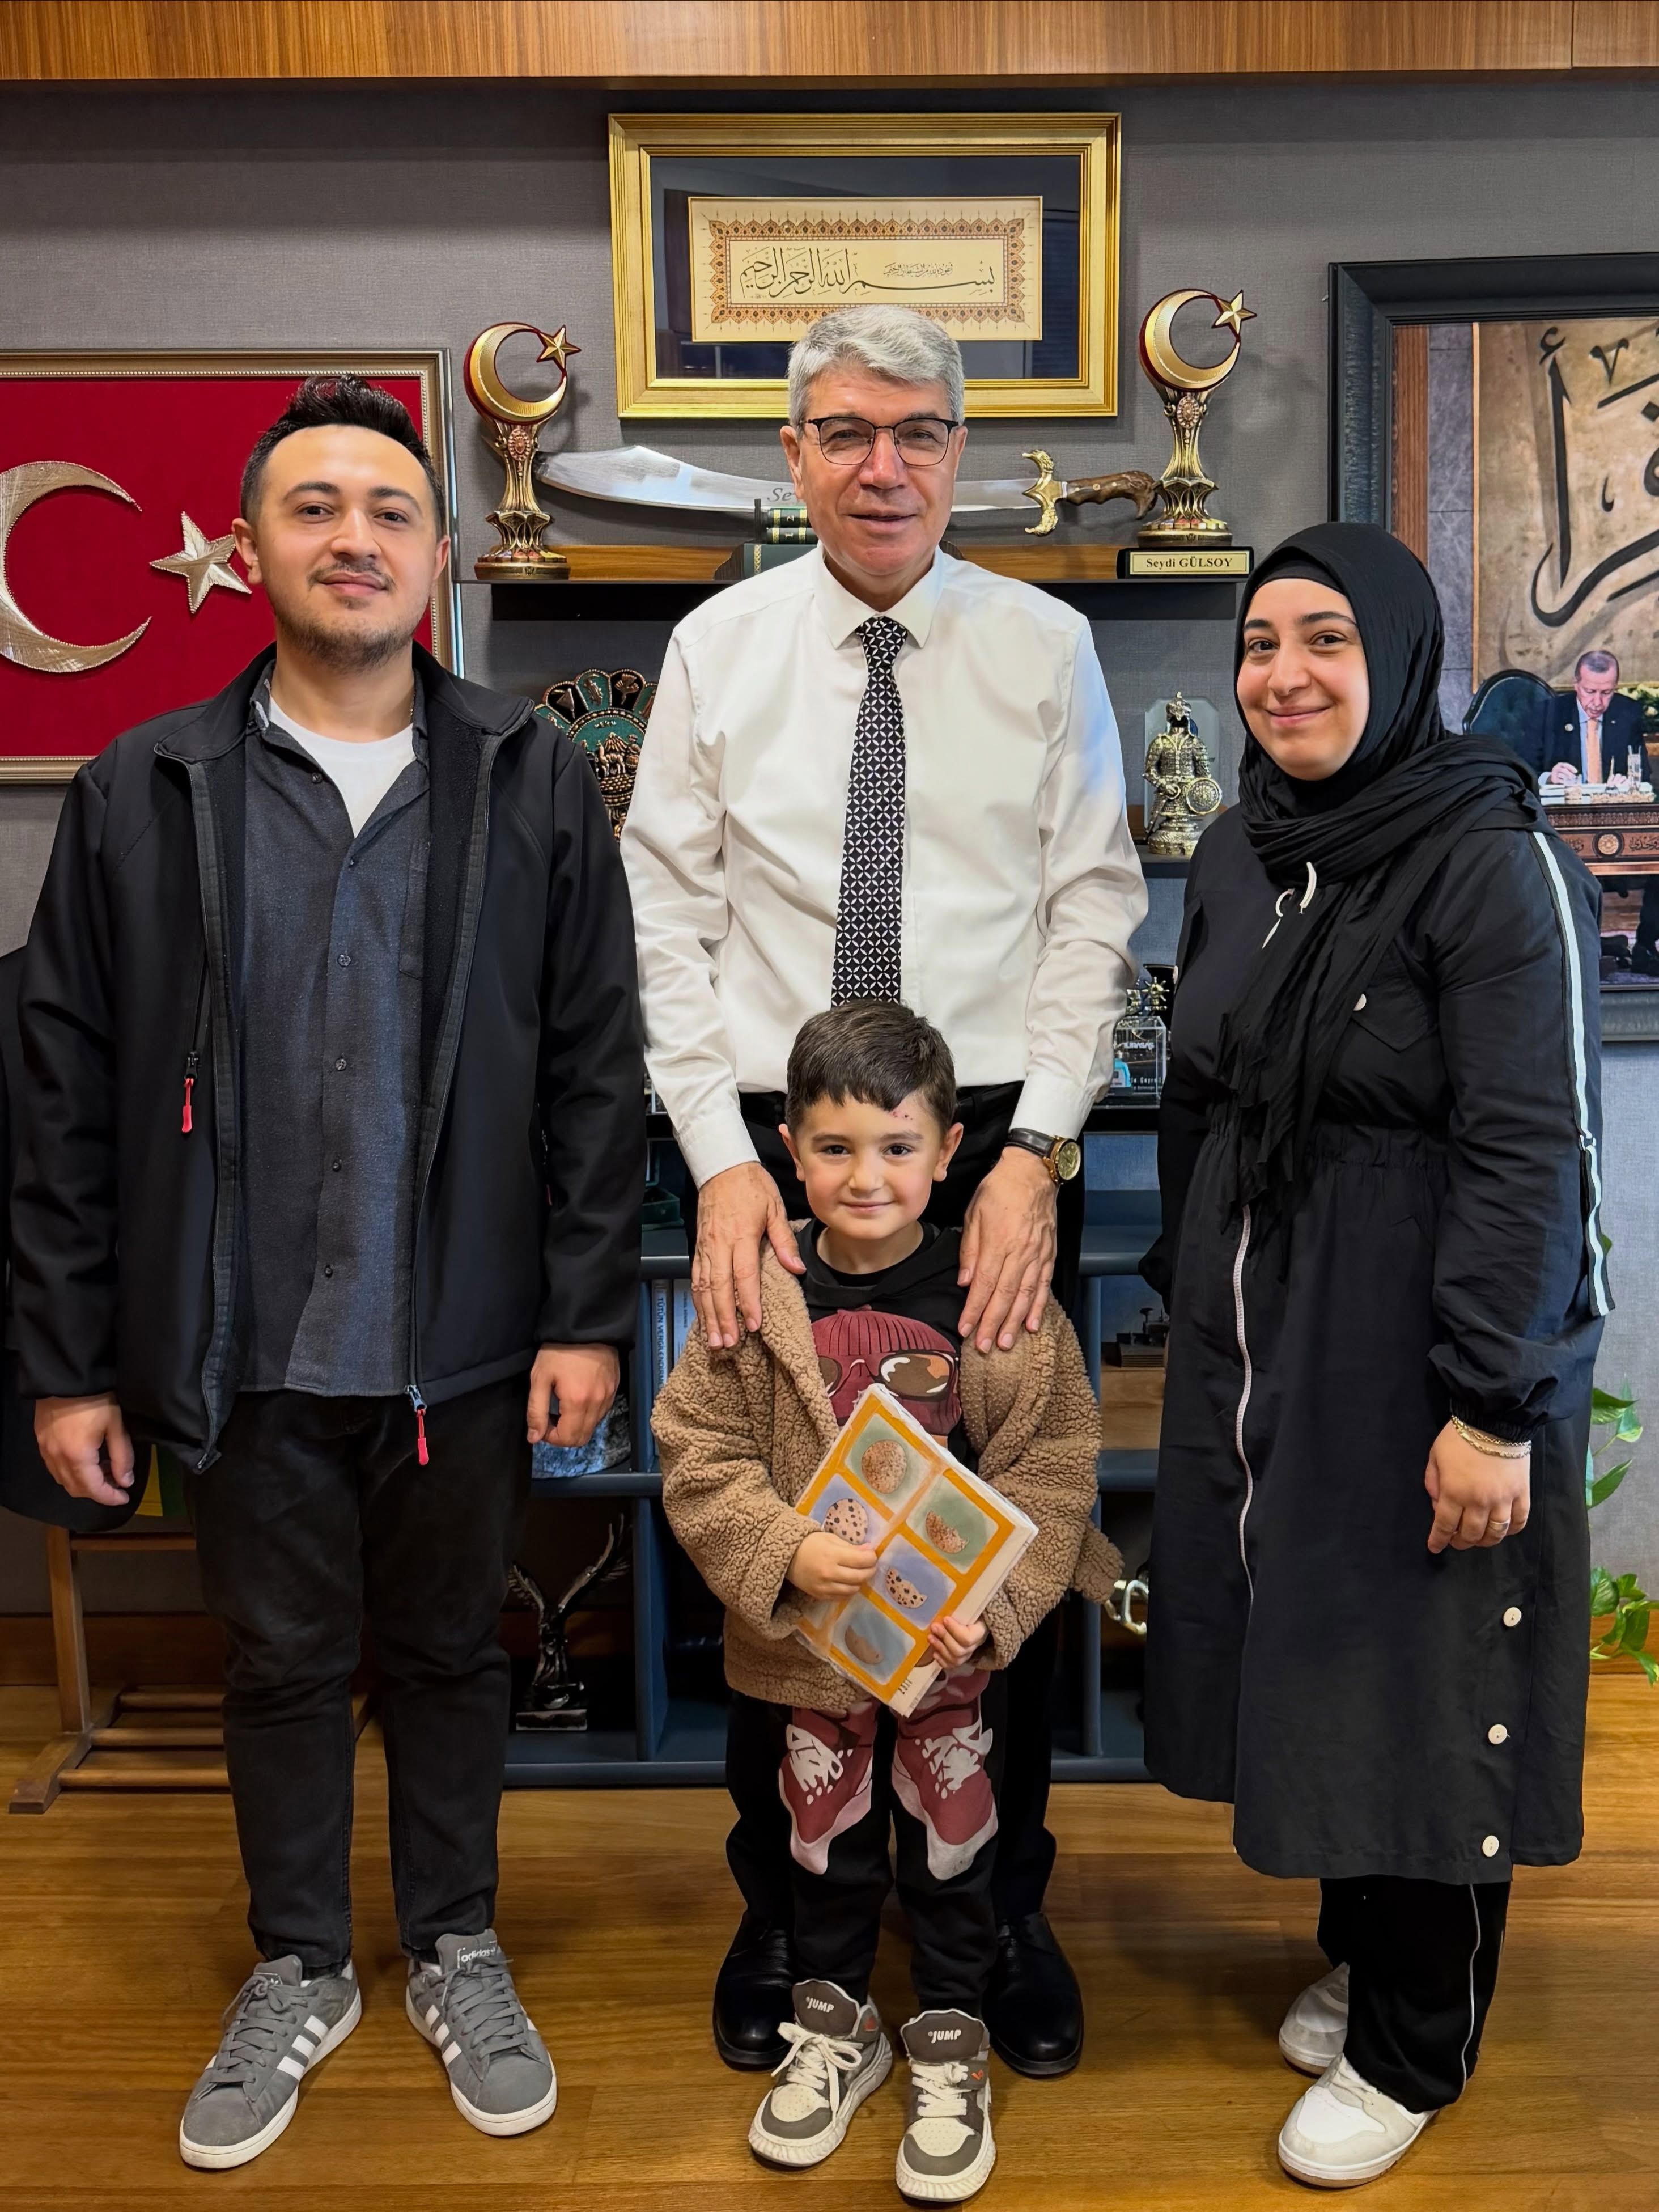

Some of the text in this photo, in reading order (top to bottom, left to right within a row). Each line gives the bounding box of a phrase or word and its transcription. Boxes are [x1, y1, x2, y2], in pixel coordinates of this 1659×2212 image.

[839, 254, 996, 295] بسم
[767, 488, 795, 502] Se
[1146, 556, 1233, 570] Seydi GÜLSOY
[657, 1297, 666, 1323] TÜTÜN
[461, 1948, 490, 1963] adidas
[807, 1997, 834, 2013] JUMP
[931, 2029, 962, 2043] JUMP
